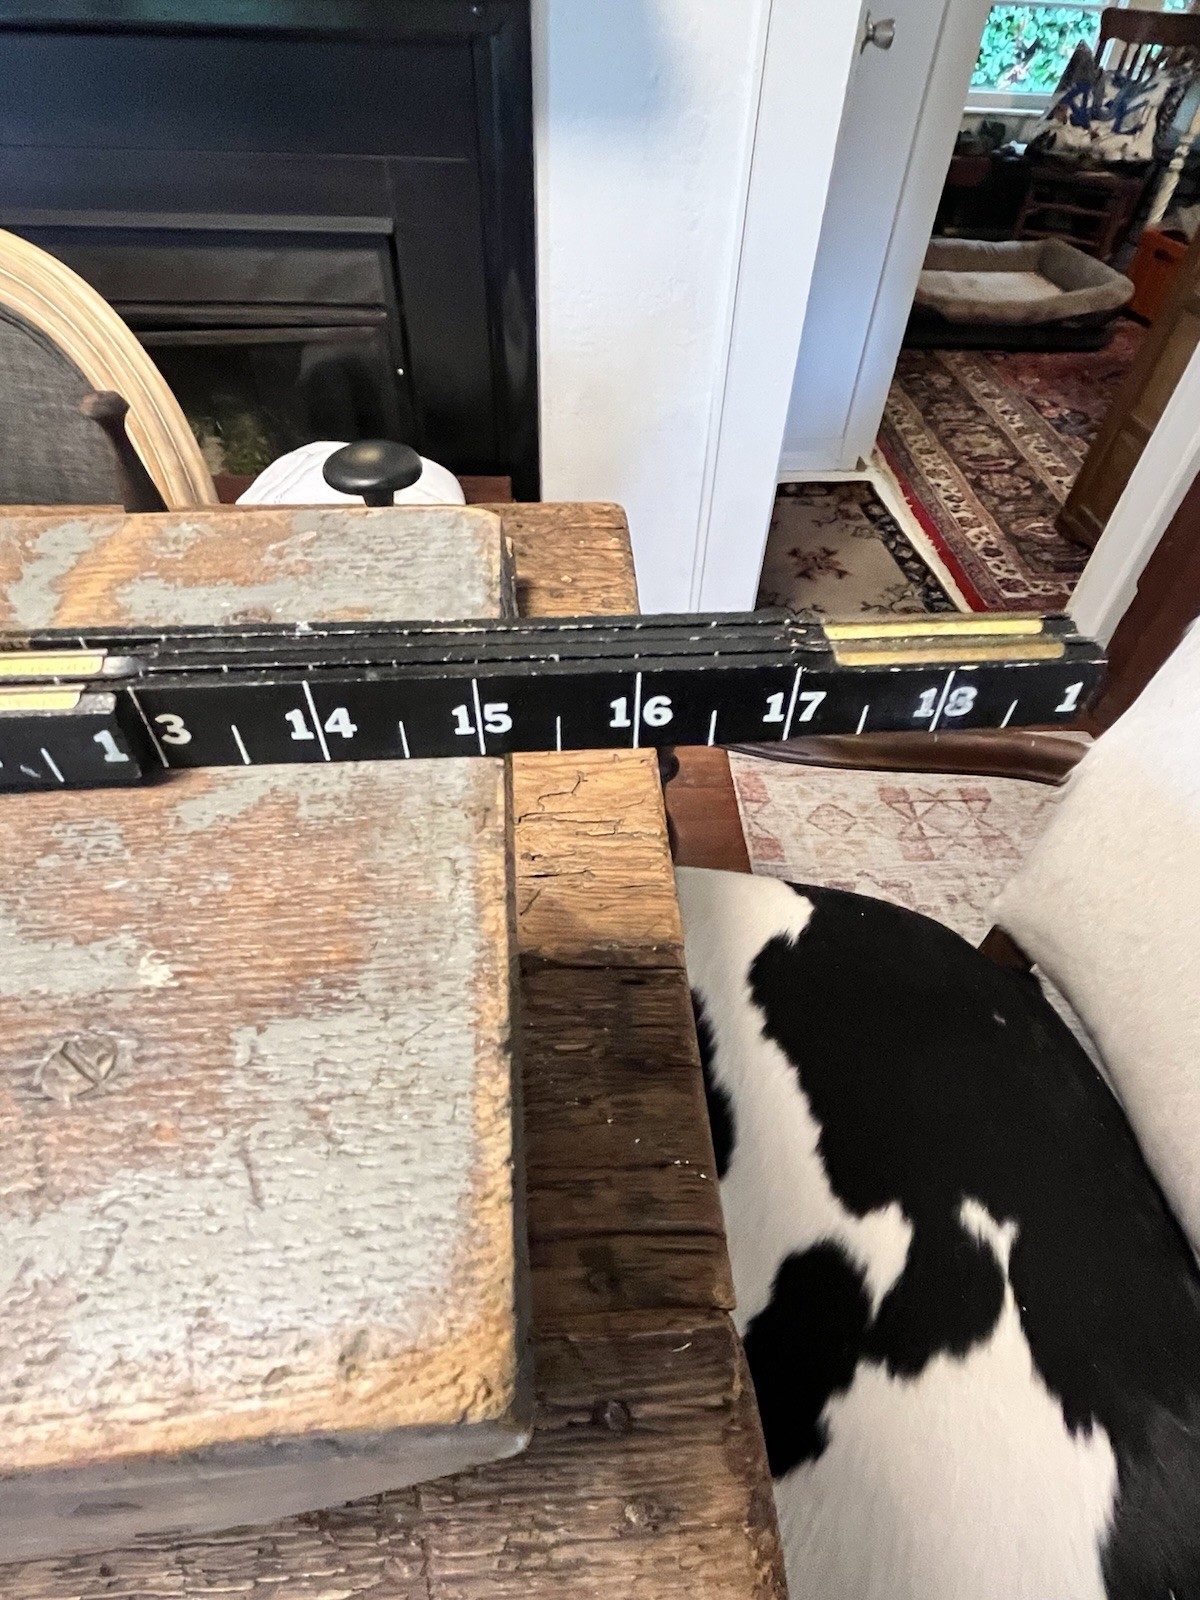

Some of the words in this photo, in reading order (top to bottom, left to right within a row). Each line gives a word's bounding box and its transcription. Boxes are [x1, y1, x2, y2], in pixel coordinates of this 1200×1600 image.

[285, 707, 358, 740] 14
[452, 702, 513, 735] 15
[609, 695, 674, 728] 16
[762, 691, 827, 722] 17
[913, 685, 978, 718] 18
[1055, 681, 1084, 713] 1
